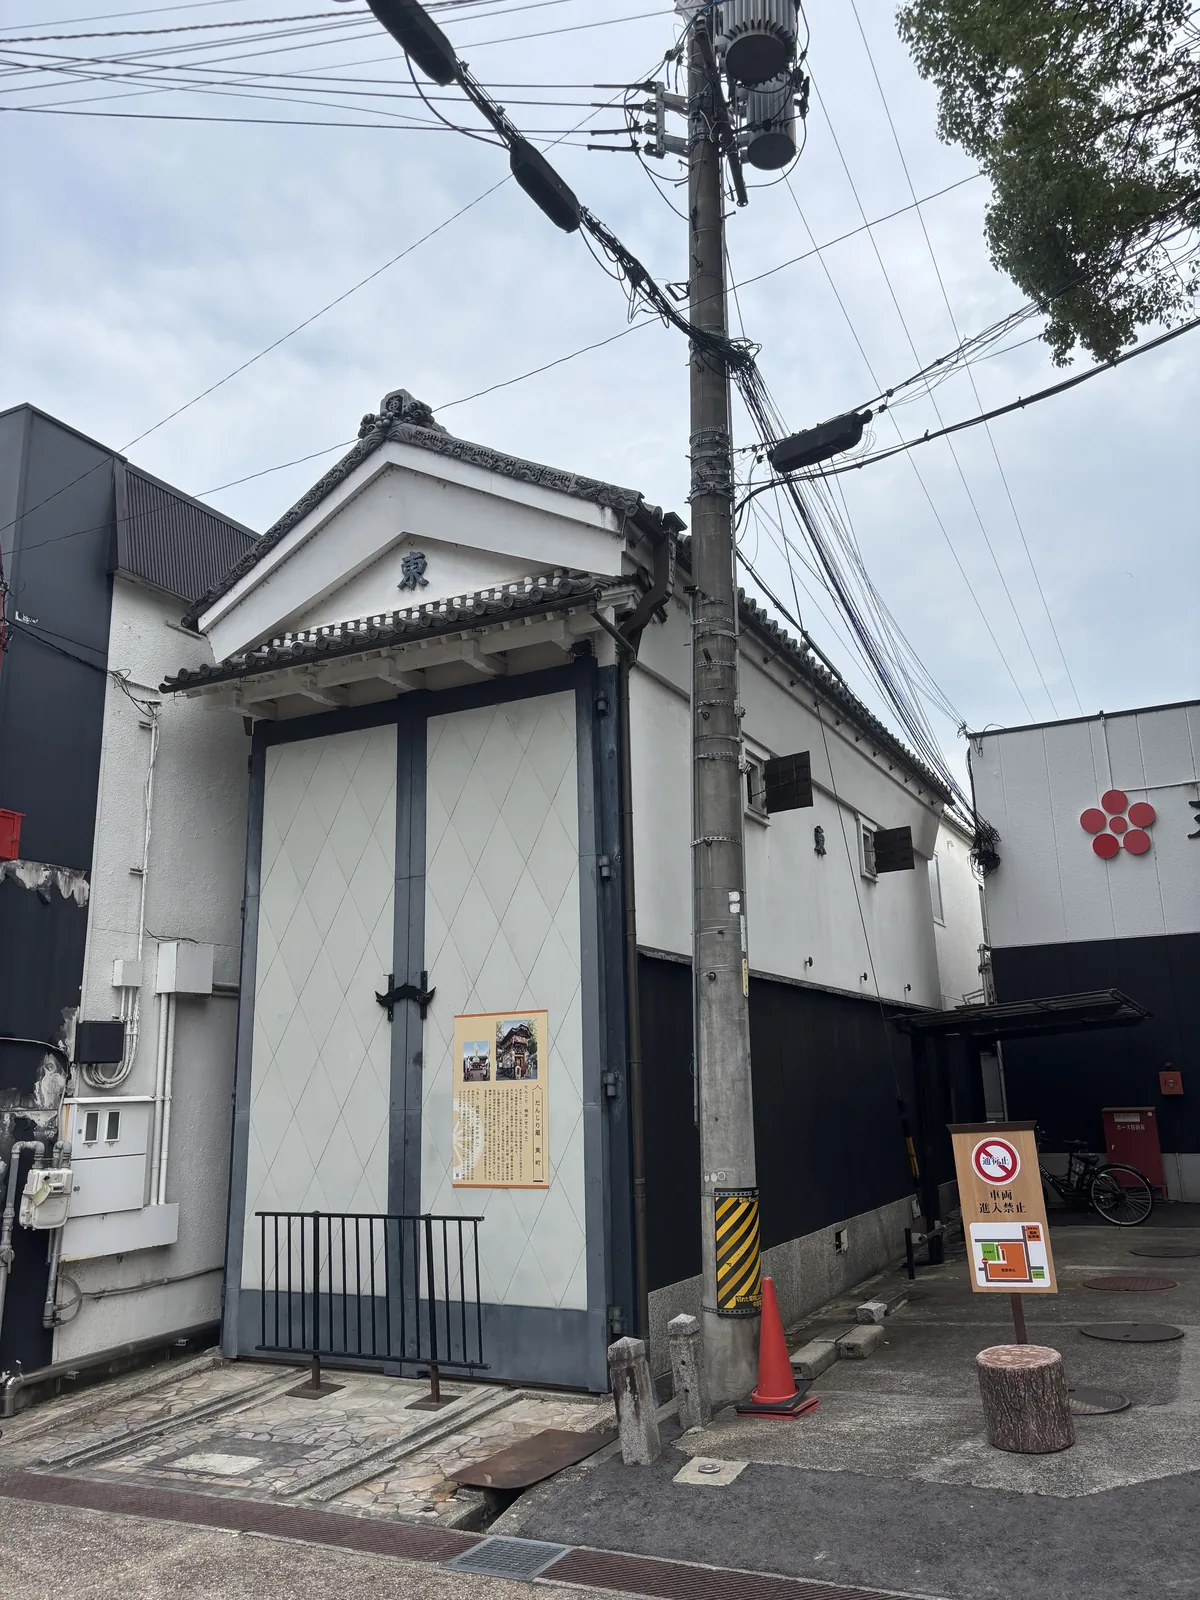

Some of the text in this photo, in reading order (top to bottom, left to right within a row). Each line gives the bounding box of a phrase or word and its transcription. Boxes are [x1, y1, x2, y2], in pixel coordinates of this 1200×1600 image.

[397, 551, 429, 590] 東
[990, 1189, 1012, 1200] 車両
[979, 1202, 1027, 1213] 進入禁止
